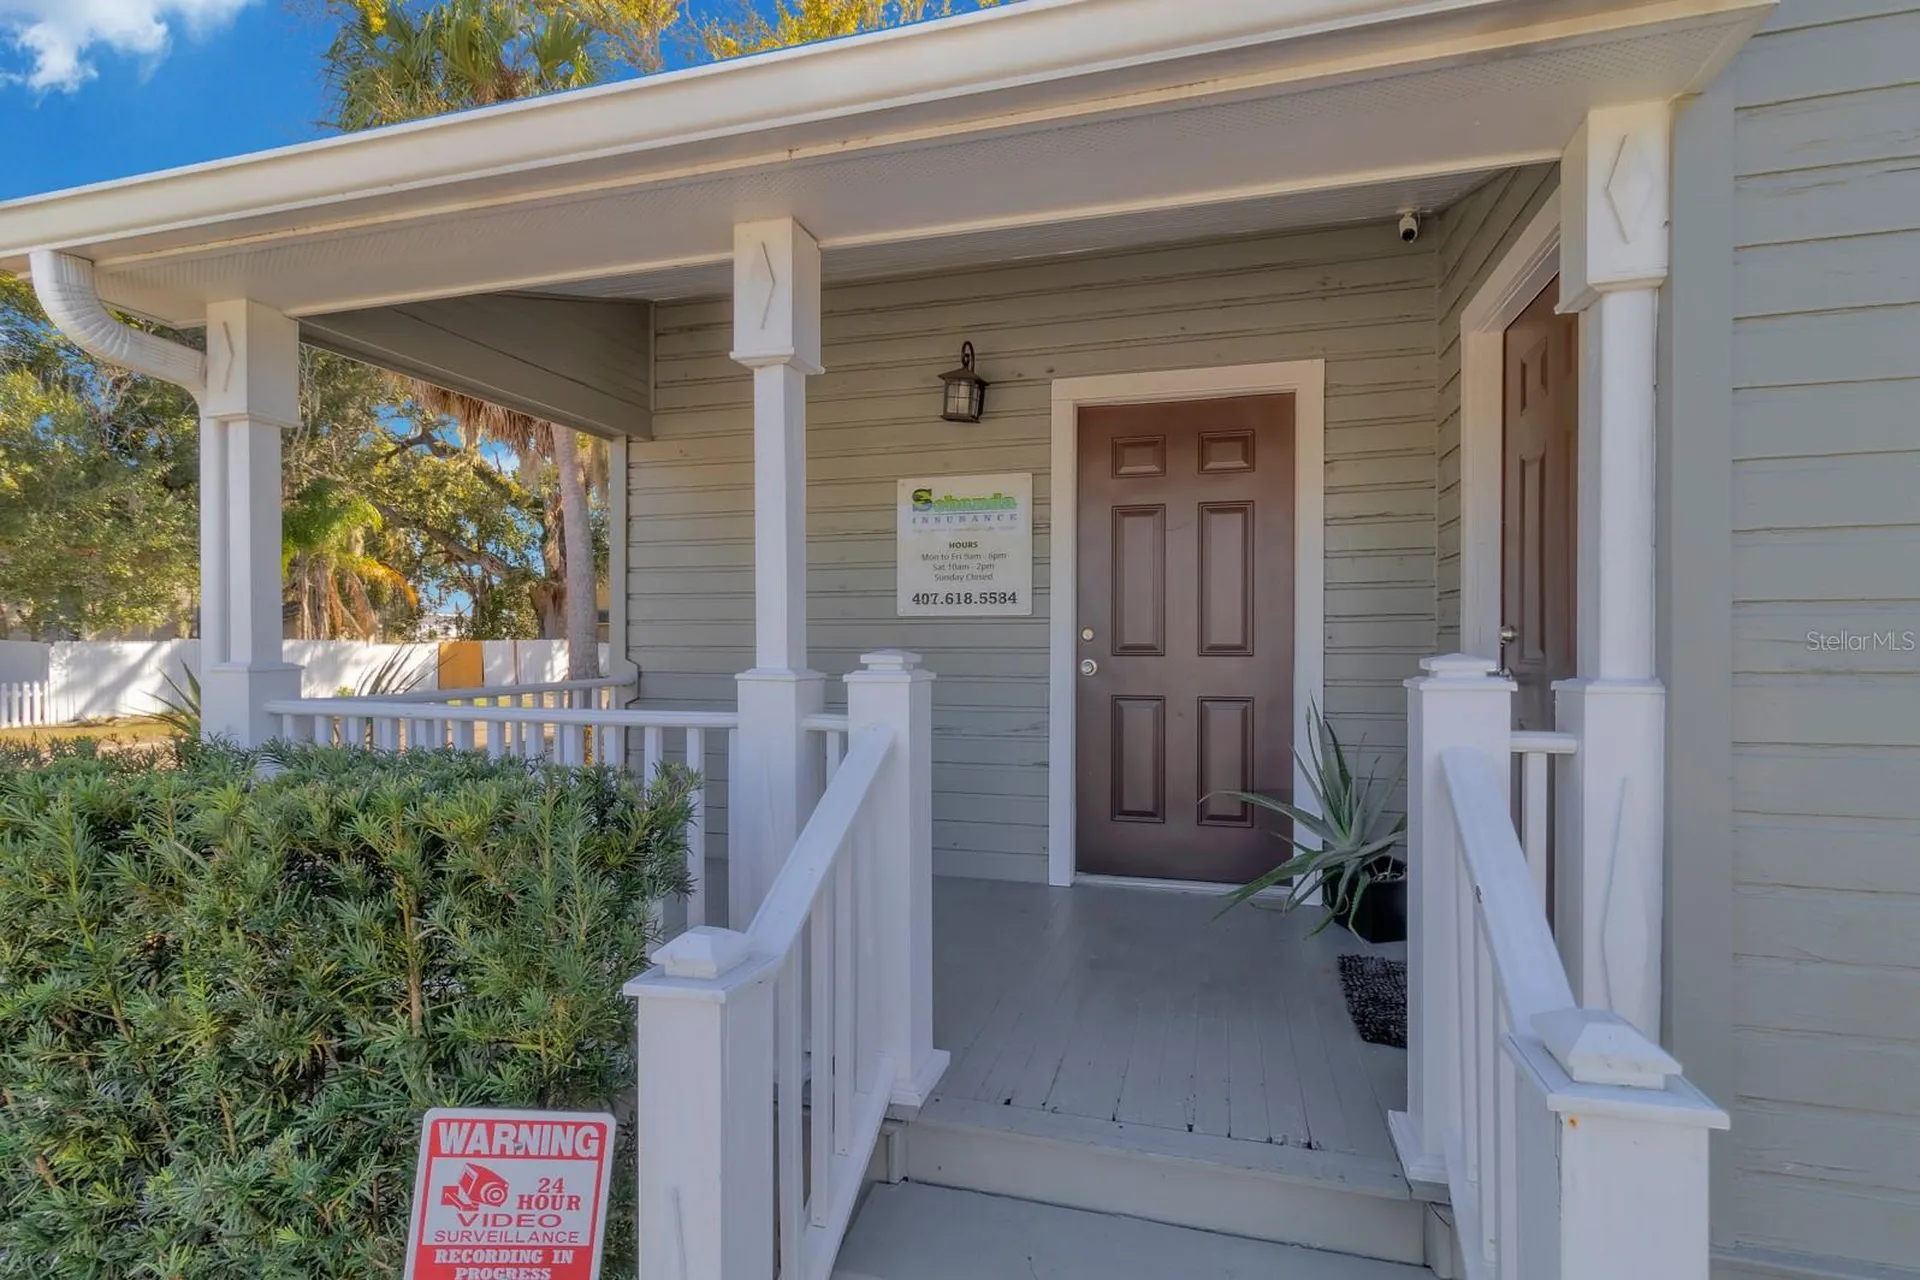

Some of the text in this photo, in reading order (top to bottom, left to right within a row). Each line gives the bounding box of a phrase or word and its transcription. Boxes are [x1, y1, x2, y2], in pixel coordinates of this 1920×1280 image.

[912, 513, 1017, 524] INSURANCE
[949, 541, 979, 549] HOURS
[940, 552, 950, 560] to
[951, 552, 962, 560] Fri
[933, 563, 945, 571] Sat
[948, 562, 969, 571] 10am
[976, 562, 995, 572] 2pm
[934, 572, 993, 582] Sunday Closed
[912, 591, 1017, 605] 407.618.5584
[438, 1122, 600, 1158] WARNING
[538, 1177, 564, 1194] 24
[516, 1194, 581, 1211] HOUR
[456, 1213, 563, 1228] VIDEO
[433, 1230, 580, 1244] SURVEILLANCE
[433, 1249, 575, 1265] RECORDING IN
[454, 1267, 552, 1280] PROGRESS
